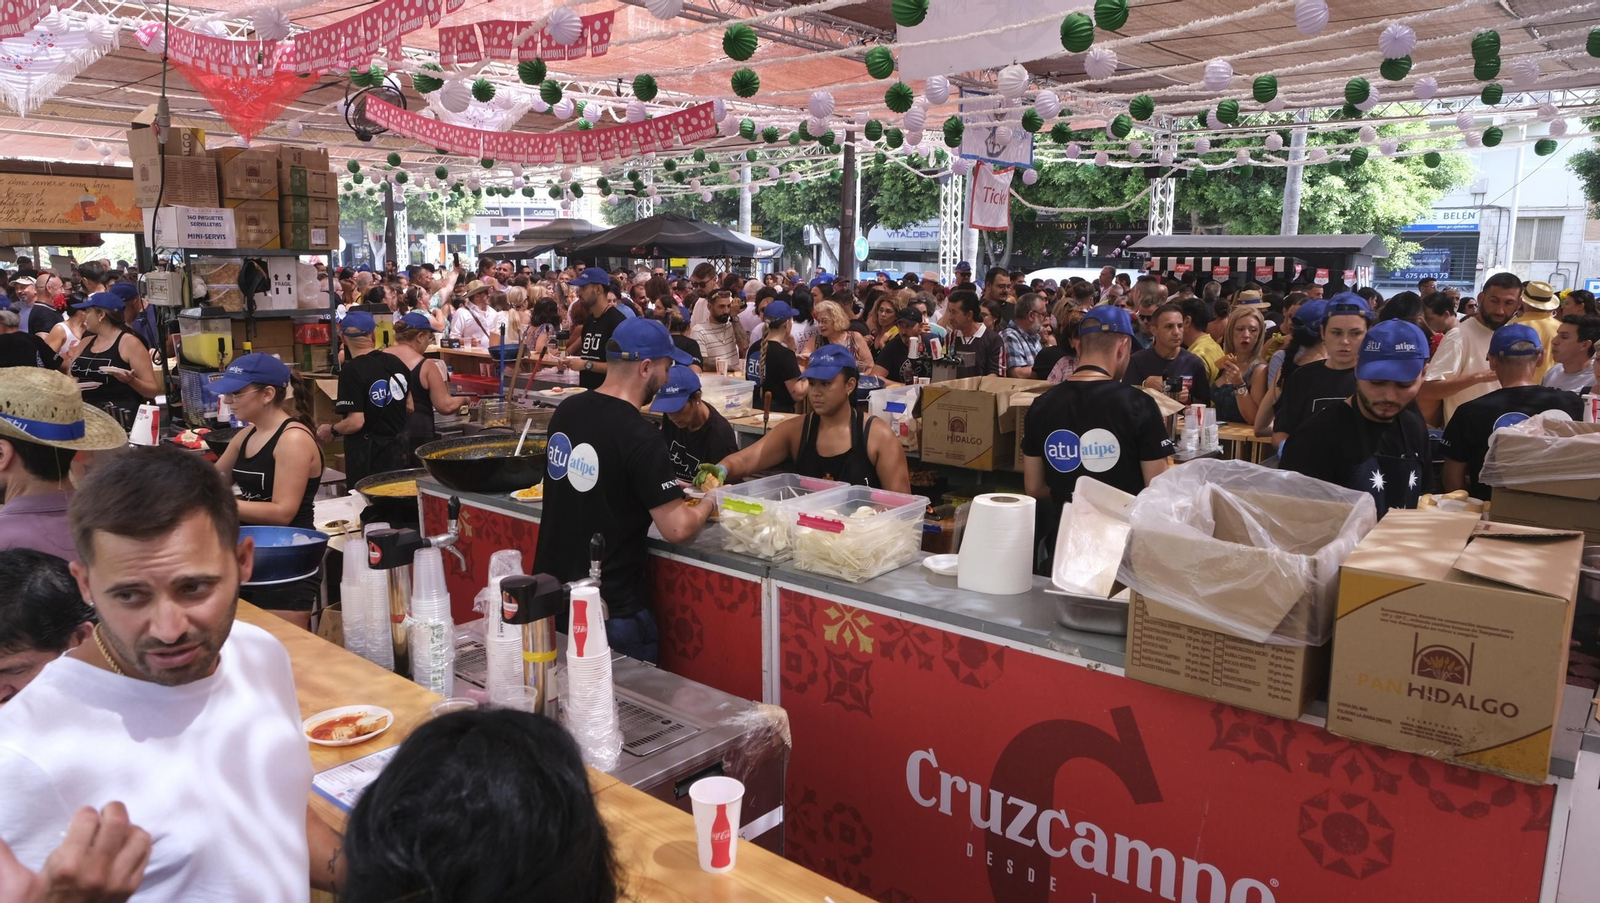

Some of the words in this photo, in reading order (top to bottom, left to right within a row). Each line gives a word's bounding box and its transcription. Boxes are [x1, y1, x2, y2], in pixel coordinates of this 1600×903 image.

[457, 51, 480, 61] CARTOJAL
[886, 231, 939, 239] VITALDENT
[1395, 342, 1416, 352] atipe
[666, 385, 680, 393] atipe
[946, 434, 983, 446] HIDALGO
[548, 445, 568, 468] atu
[1048, 441, 1078, 458] atu
[1081, 442, 1116, 458] atipe
[570, 457, 596, 476] atipe
[1358, 672, 1405, 695] PAN
[1407, 682, 1520, 719] HIDALGO
[966, 842, 1058, 892] DESDE
